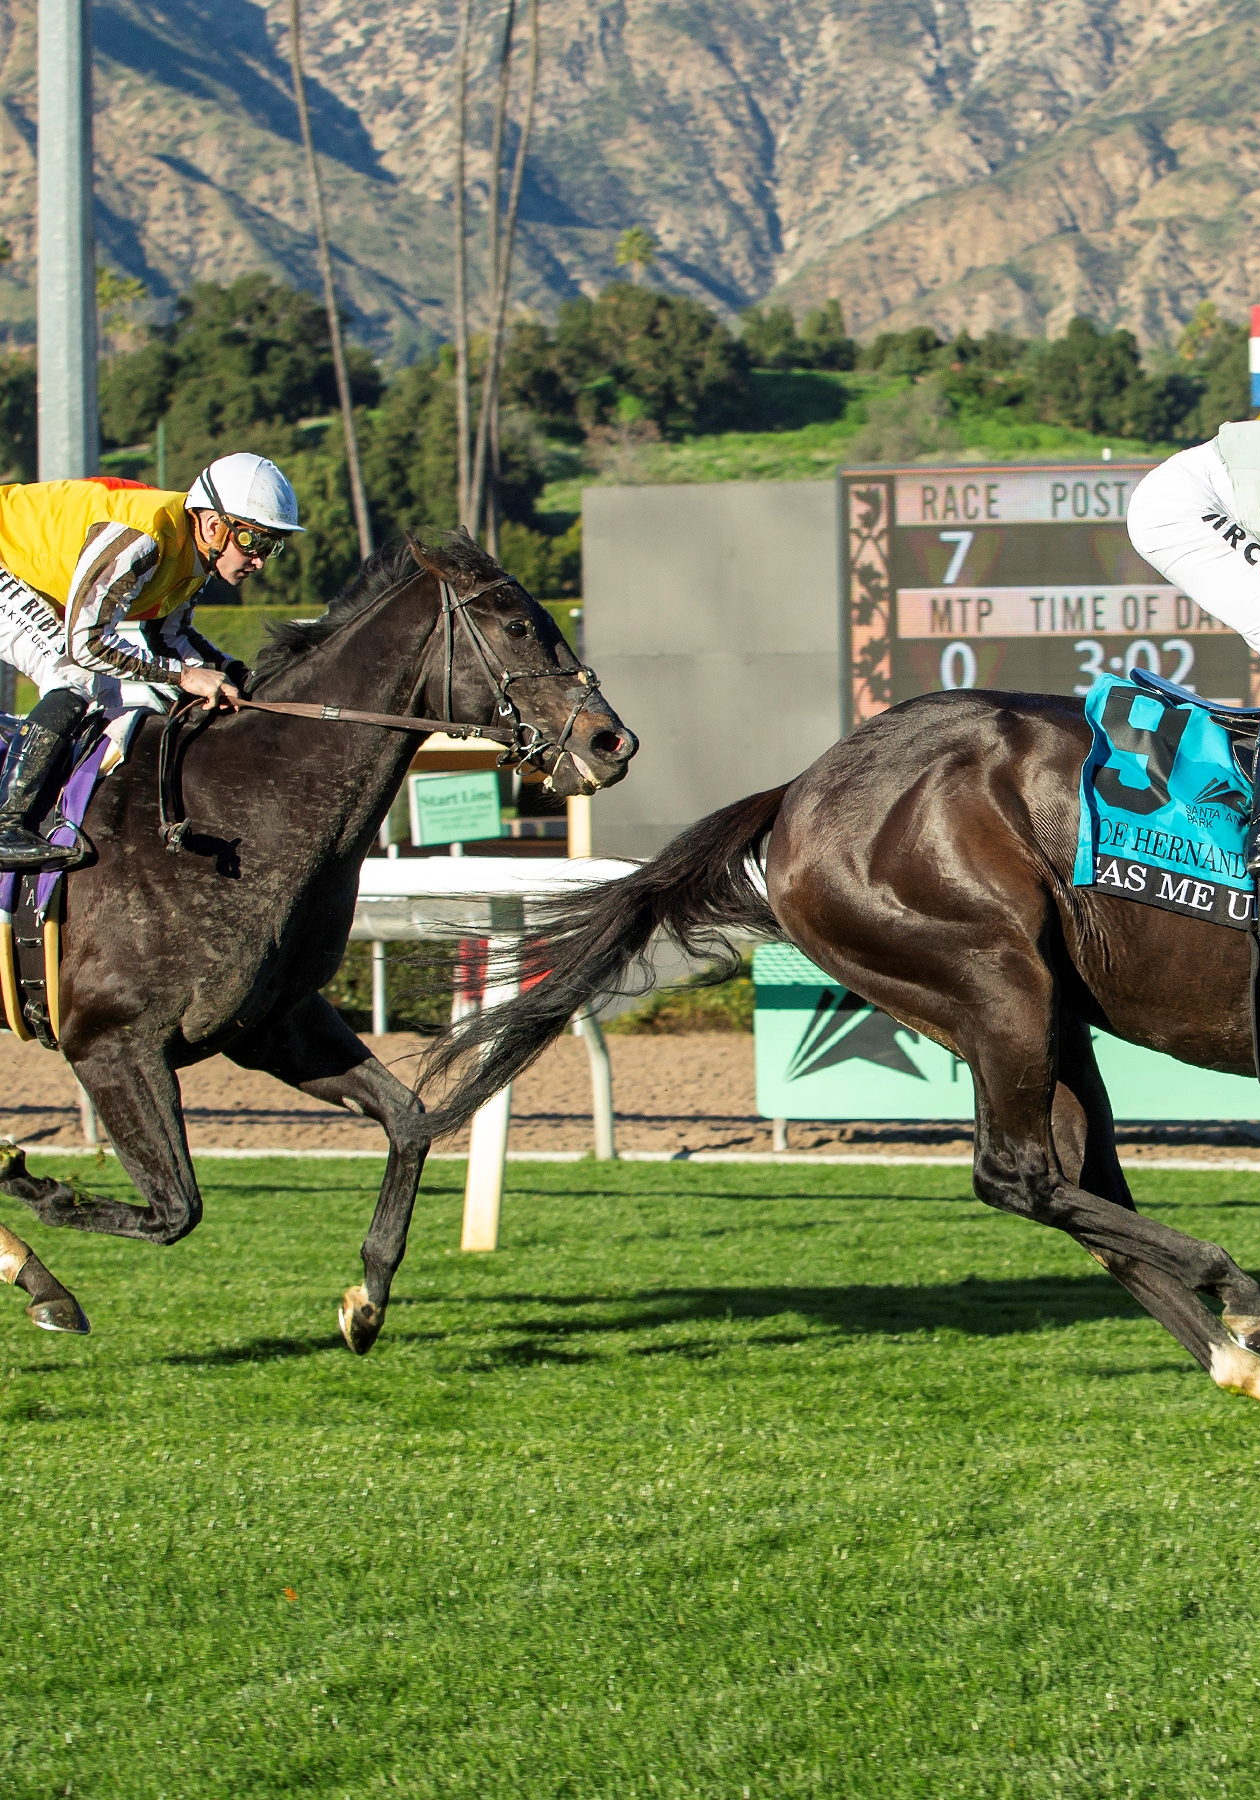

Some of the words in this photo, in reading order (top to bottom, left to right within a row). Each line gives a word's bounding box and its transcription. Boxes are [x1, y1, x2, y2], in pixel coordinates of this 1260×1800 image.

[921, 484, 999, 520] RACE
[1051, 480, 1130, 518] POST
[939, 531, 974, 584] 7
[930, 599, 994, 633] MTP
[1030, 596, 1106, 632] TIME
[1122, 594, 1159, 630] OF
[1176, 595, 1229, 629] DA
[939, 641, 977, 690] 0
[1073, 638, 1197, 697] 3:02
[1091, 685, 1192, 816] 9
[1185, 804, 1221, 821] SANTA
[1187, 813, 1213, 829] PARK
[1093, 818, 1129, 848] OE
[1096, 856, 1147, 892] AS
[1155, 872, 1215, 912] ME
[1227, 889, 1258, 921] U
